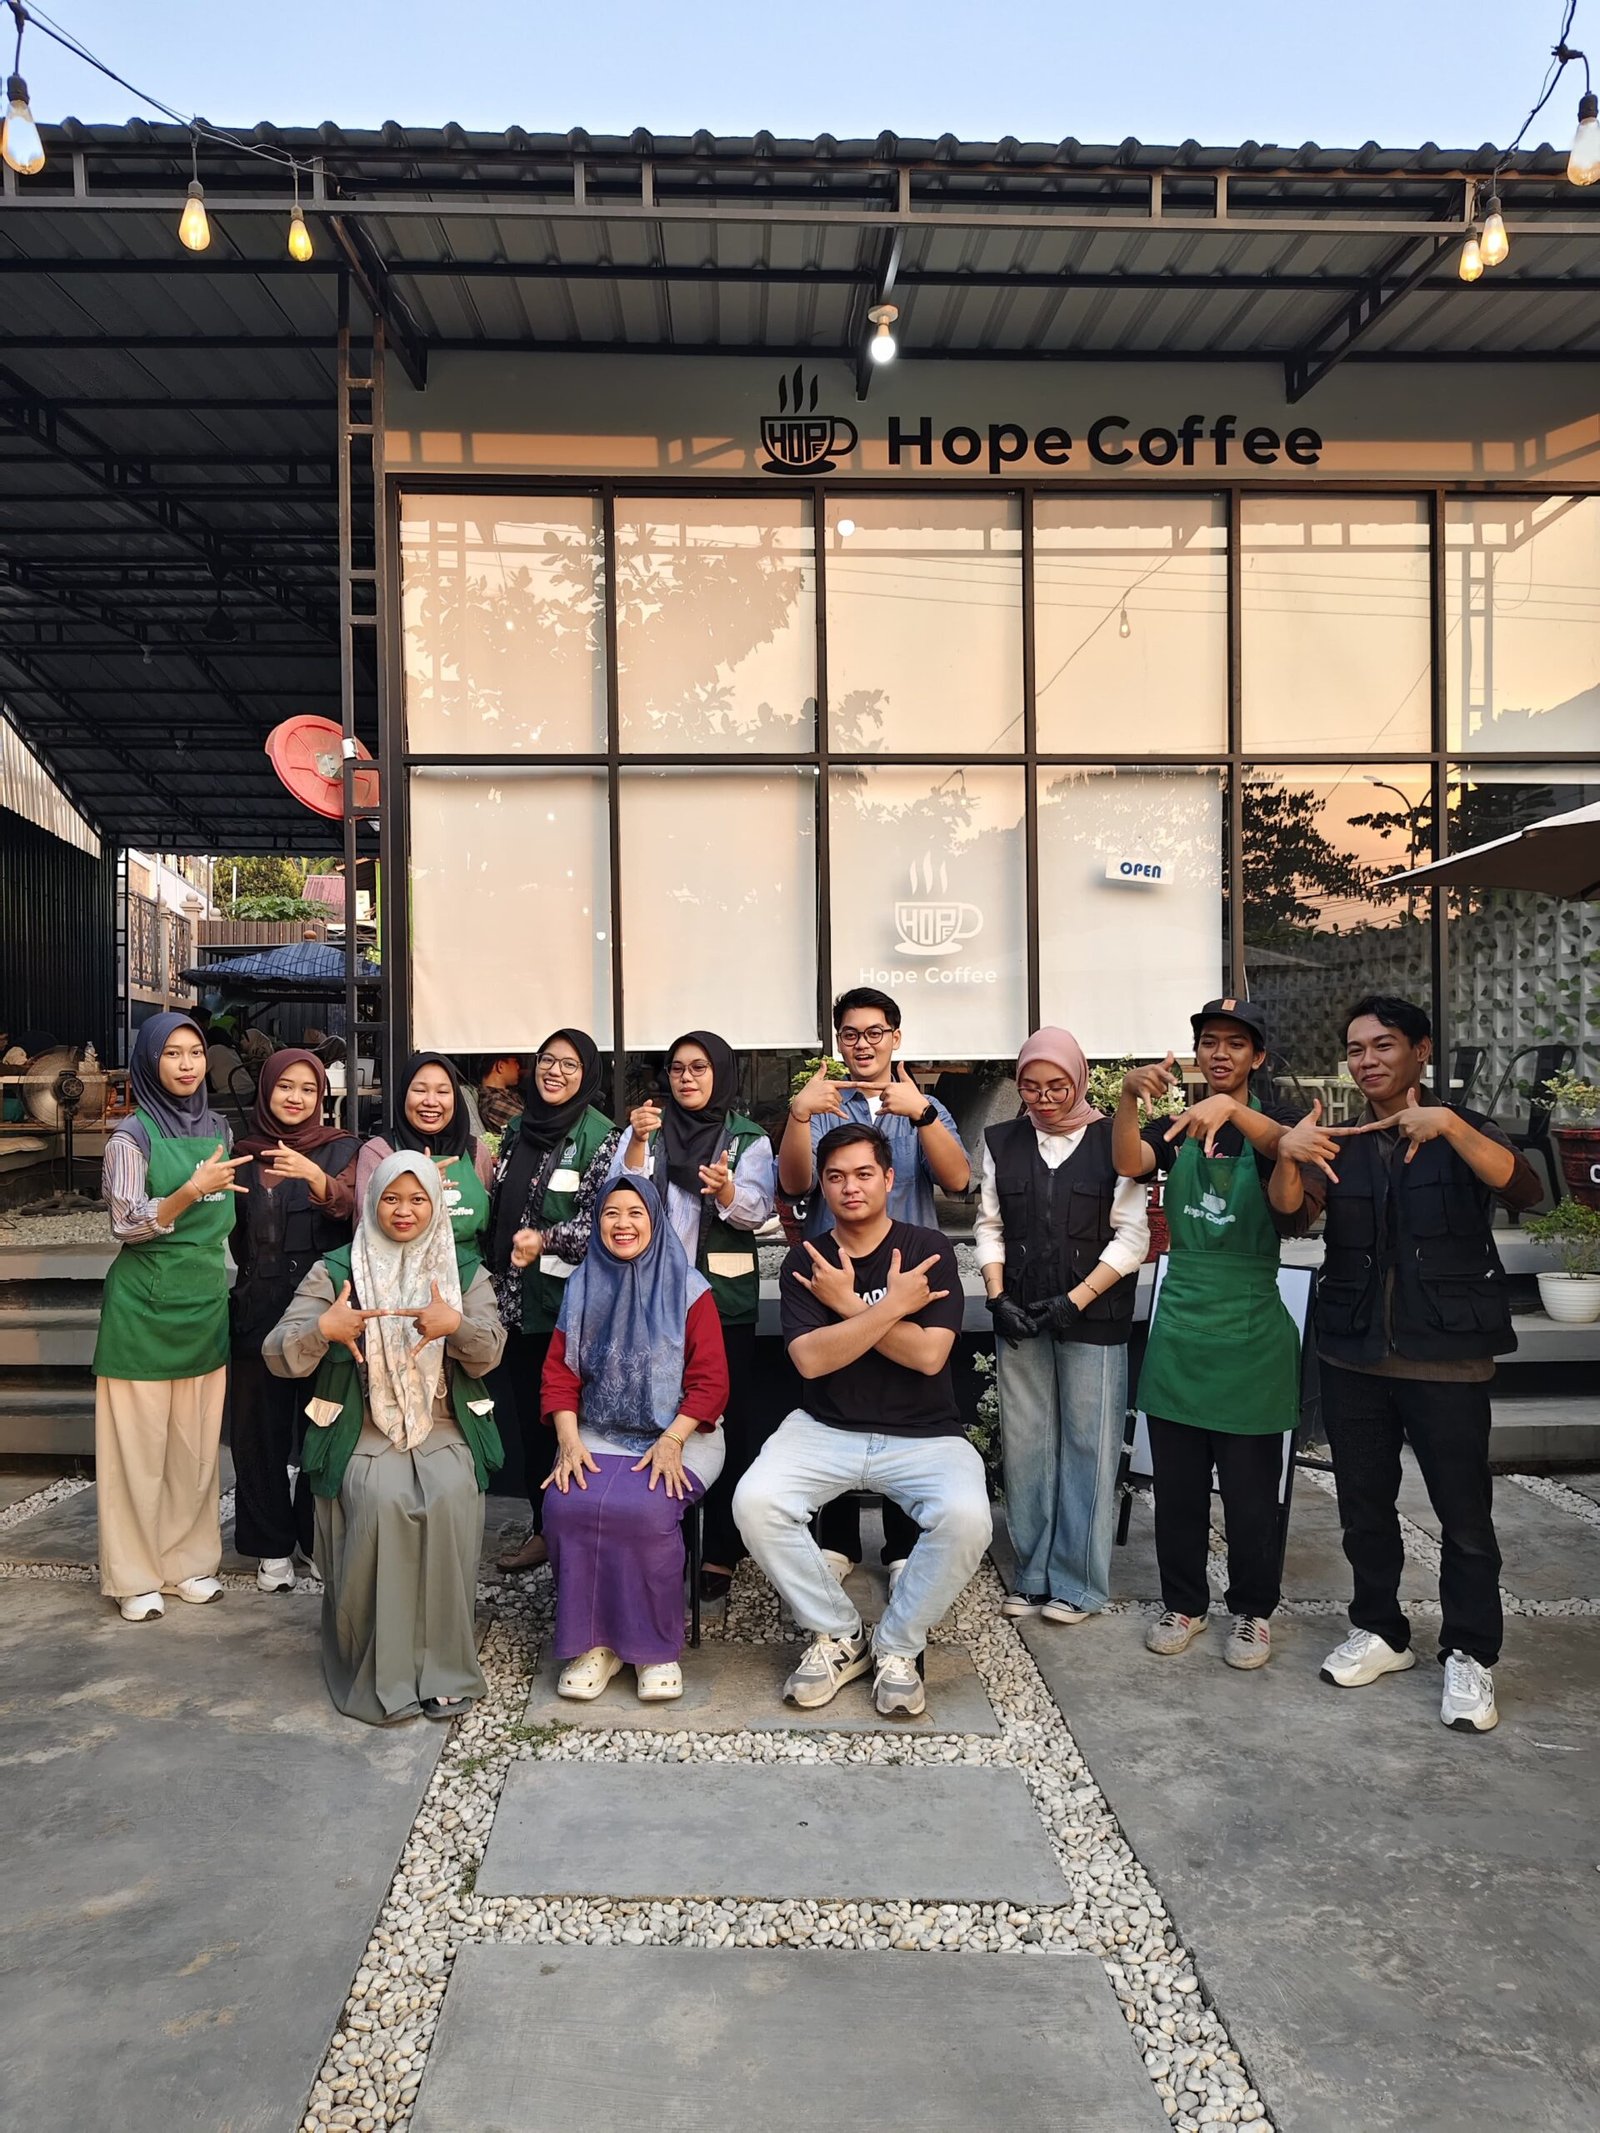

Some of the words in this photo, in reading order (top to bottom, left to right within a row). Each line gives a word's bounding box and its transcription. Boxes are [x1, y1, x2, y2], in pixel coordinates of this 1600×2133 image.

[768, 423, 826, 463] HOPE
[888, 417, 1073, 475] Hope
[1087, 414, 1323, 466] Coffee
[1120, 861, 1161, 879] OPEN
[900, 908, 957, 945] HOPE
[859, 967, 917, 988] Hope
[925, 966, 997, 984] Coffee
